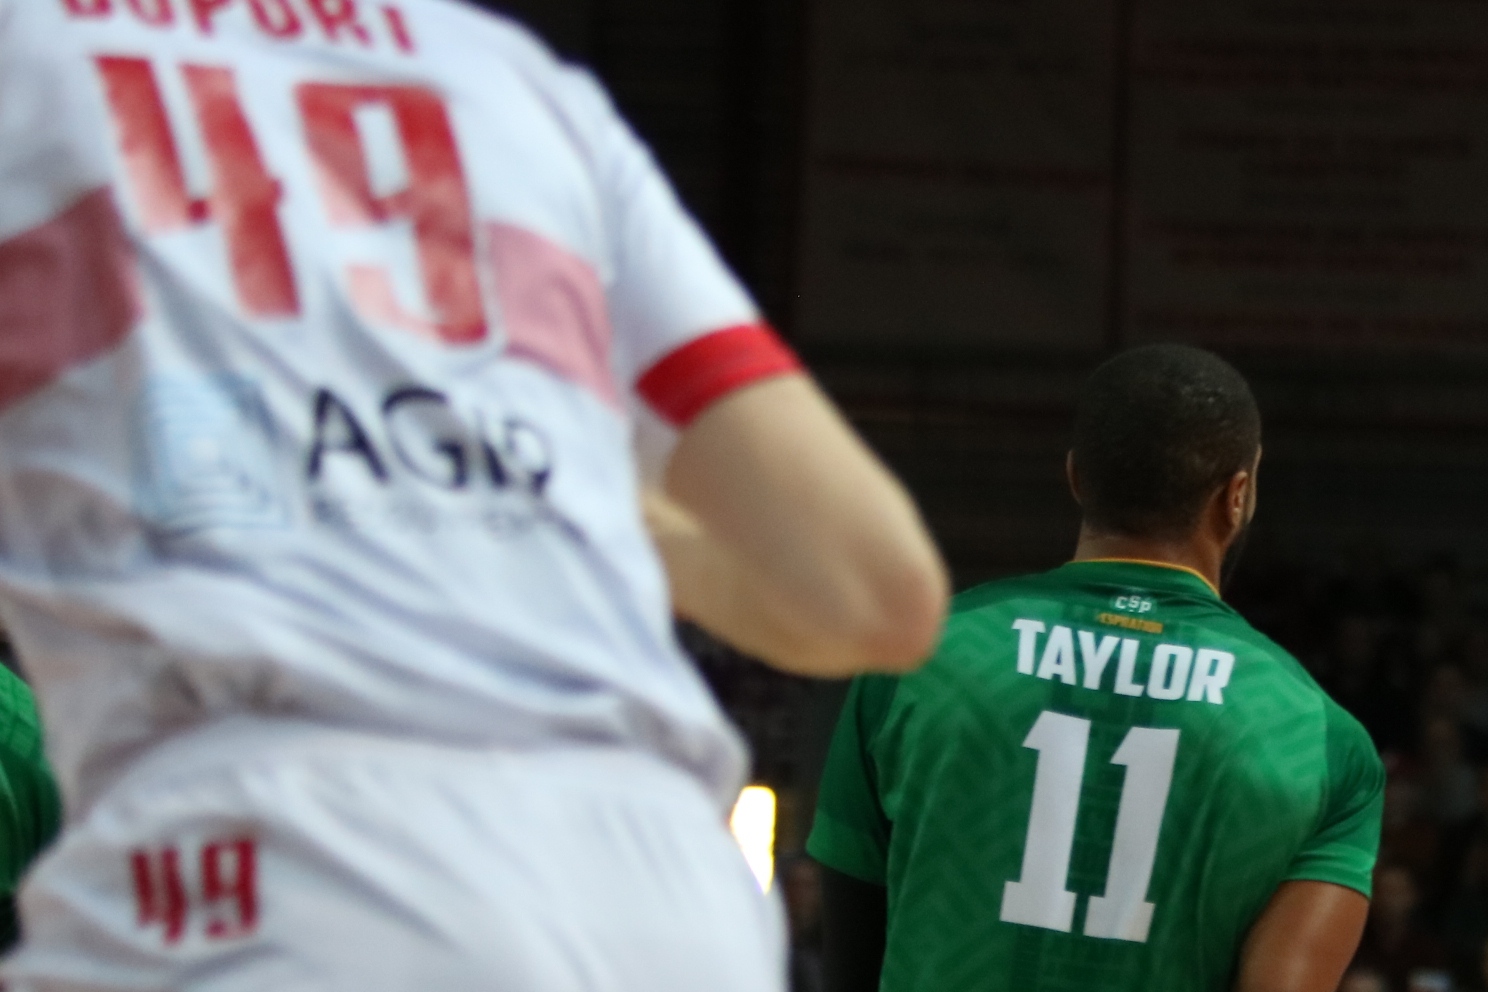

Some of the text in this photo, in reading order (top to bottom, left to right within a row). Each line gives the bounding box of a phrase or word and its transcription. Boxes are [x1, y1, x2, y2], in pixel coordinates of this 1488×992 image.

[93, 54, 489, 347] 49
[1011, 618, 1235, 705] TAYLOR
[1000, 710, 1181, 943] 11
